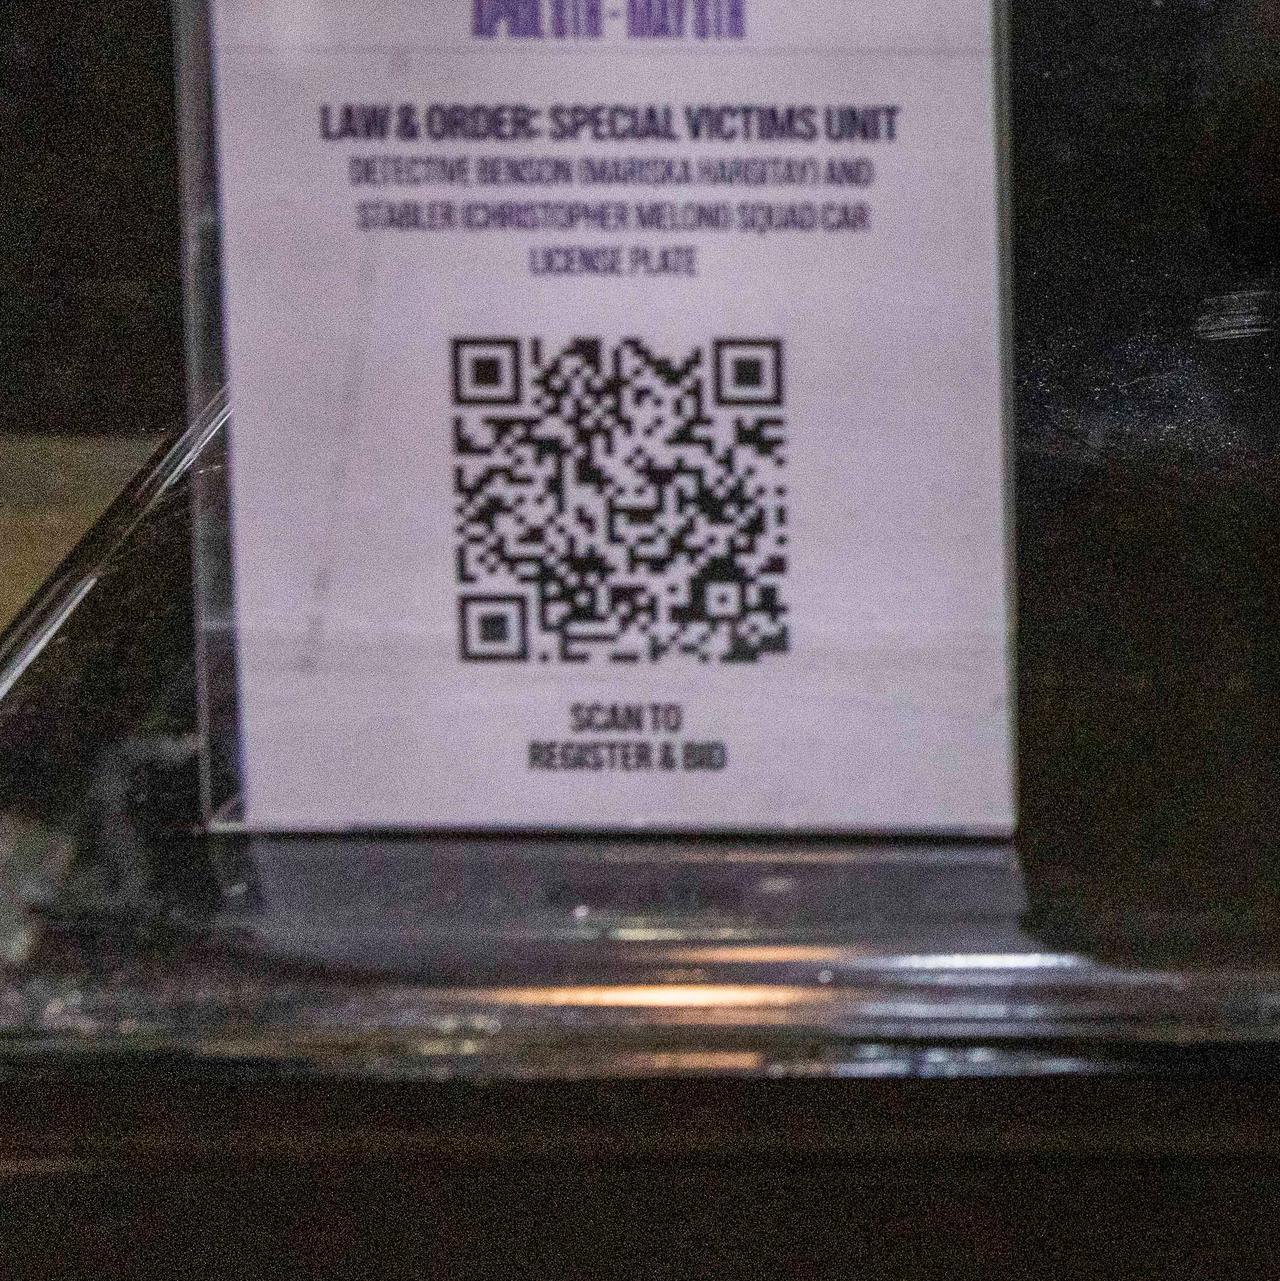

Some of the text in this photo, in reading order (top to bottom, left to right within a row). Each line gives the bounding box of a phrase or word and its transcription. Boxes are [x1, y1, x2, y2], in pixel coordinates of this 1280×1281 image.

[319, 103, 900, 141] LAW & ORDER: SPECIAL VICTIMS UNIT
[348, 156, 470, 187] DETECTIVE
[476, 156, 573, 187] BENSON
[824, 156, 874, 187] AND
[355, 200, 456, 232] STABLER
[737, 200, 817, 234] SQUAD
[821, 200, 872, 232] CAR
[529, 246, 697, 277] LICENSE PLATE
[569, 702, 684, 733] SCAN TO
[527, 741, 728, 771] REGISTER & BID
